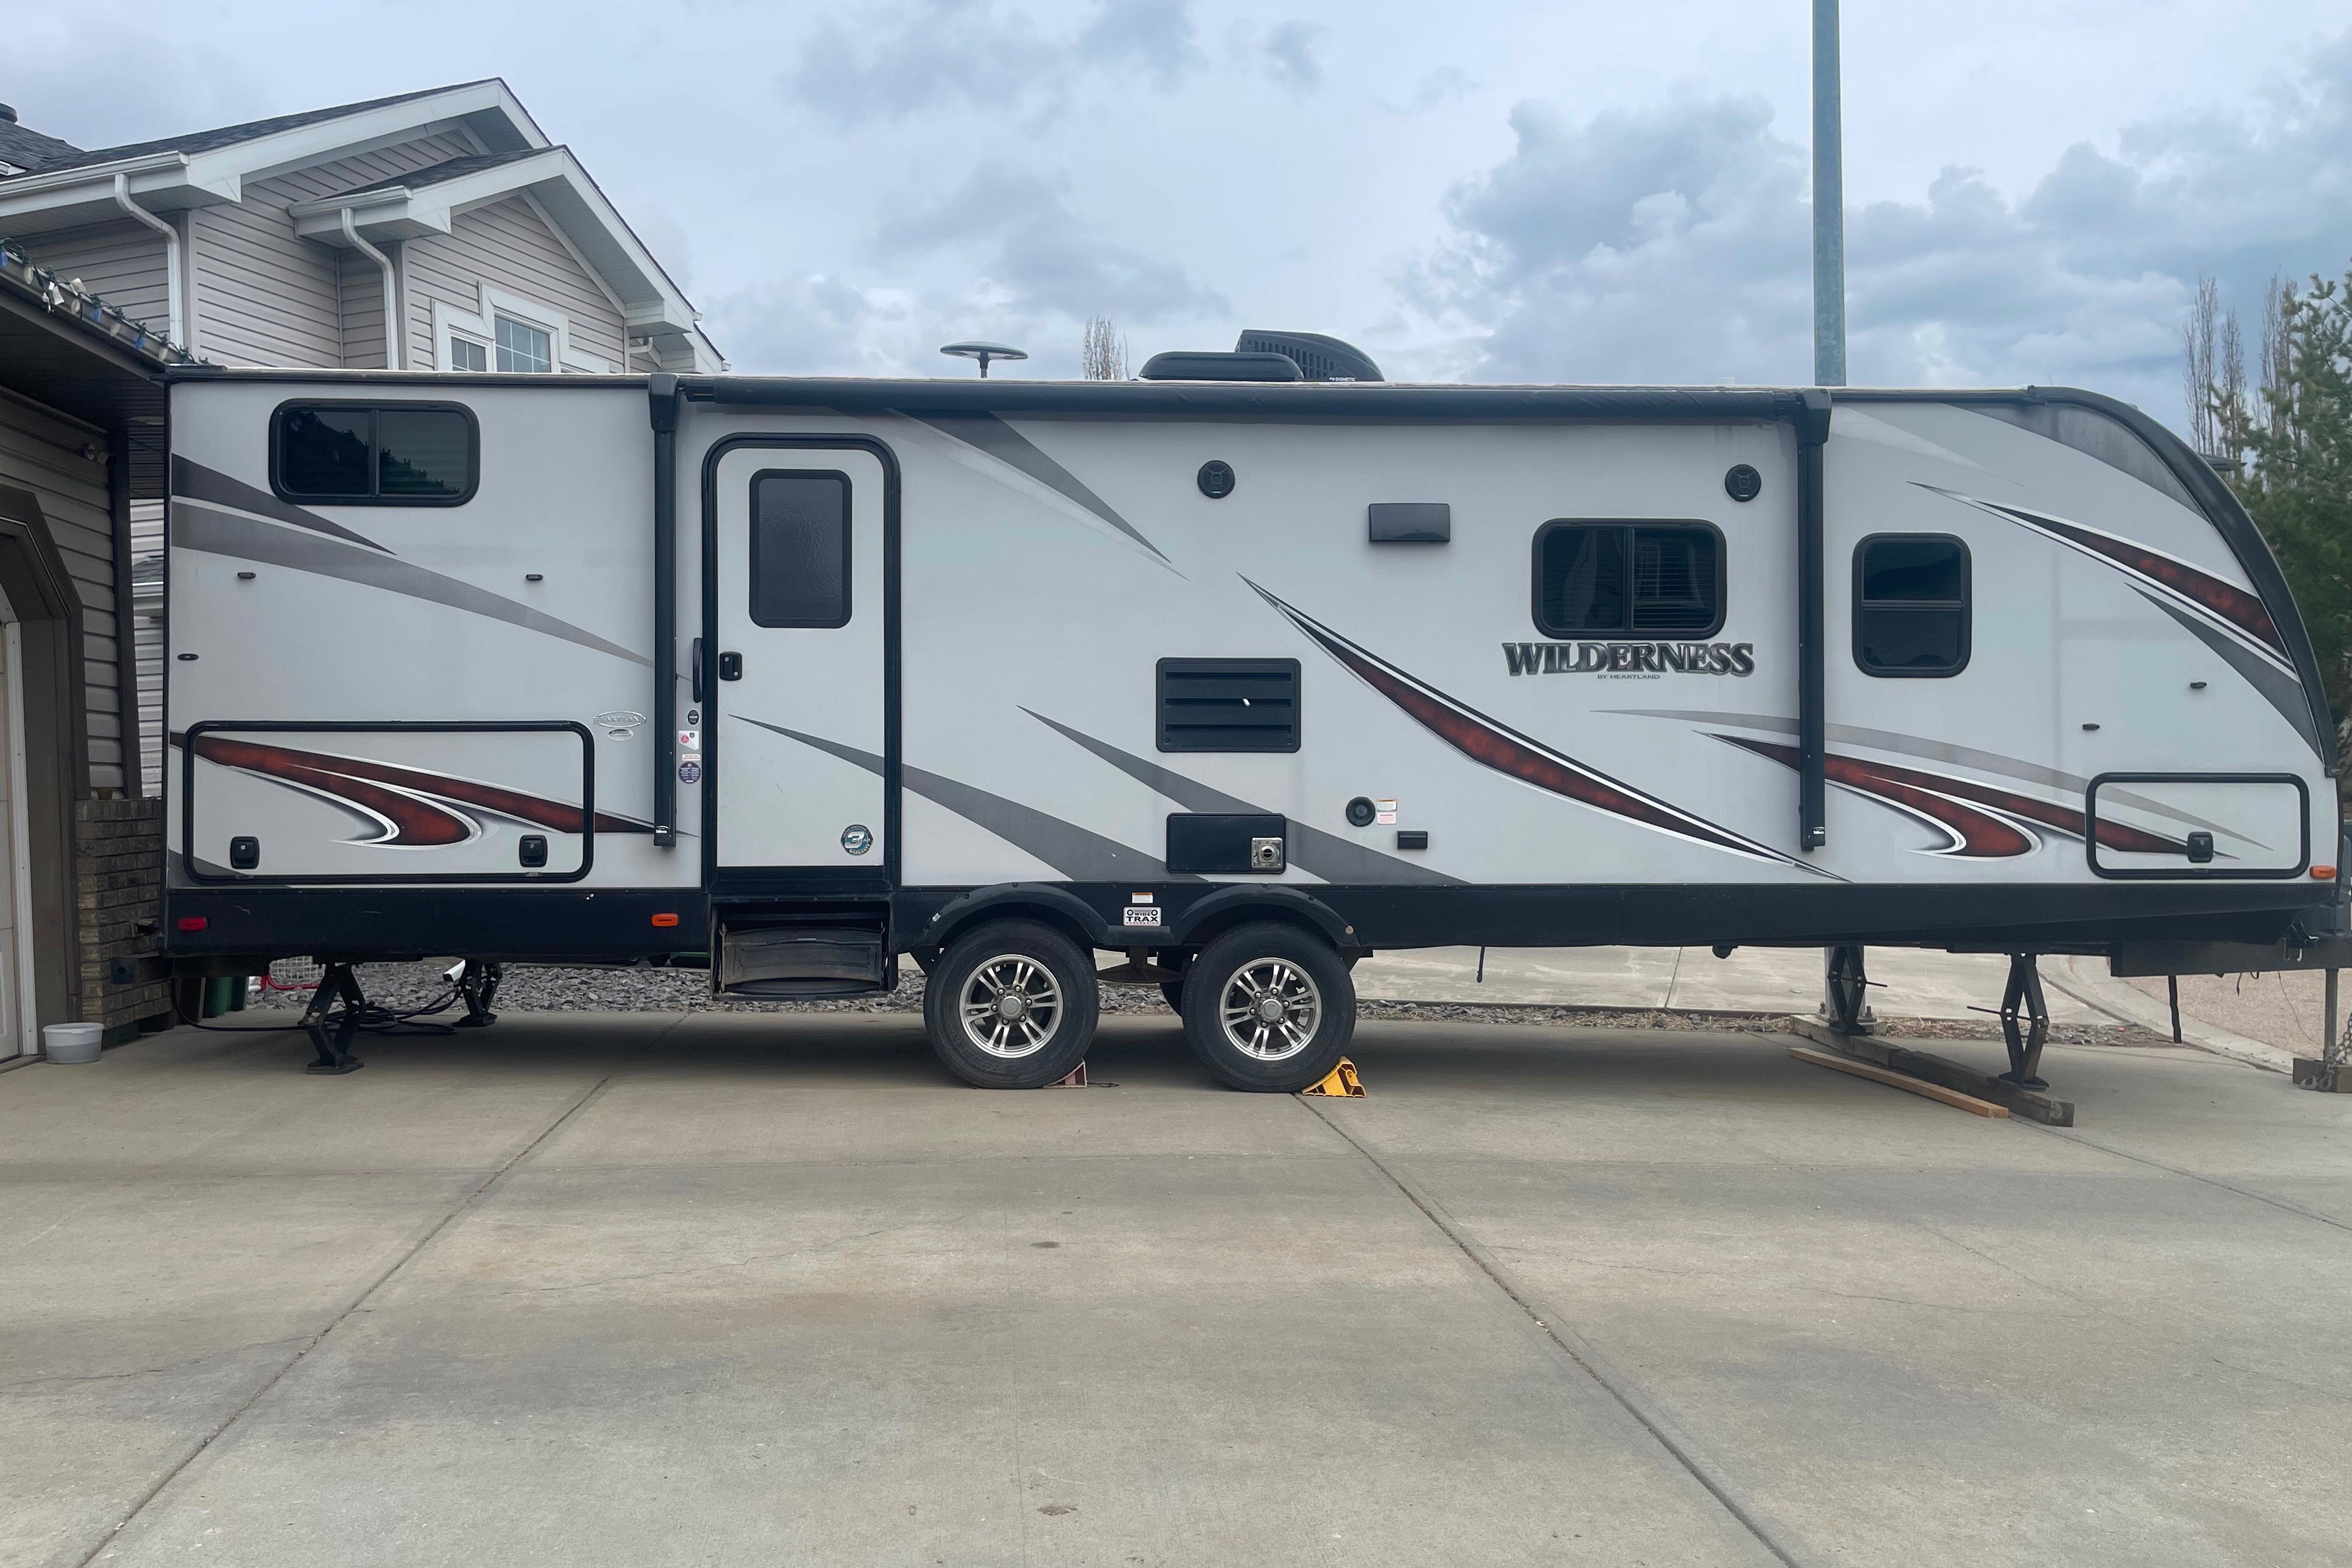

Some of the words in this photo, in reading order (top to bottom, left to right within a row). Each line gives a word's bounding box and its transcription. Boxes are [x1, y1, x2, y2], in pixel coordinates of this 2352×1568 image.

[1502, 642, 1755, 677] WILDERNESS
[593, 716, 647, 725] HEARTLAND
[844, 831, 865, 849] 3
[849, 844, 871, 854] WARRANTY
